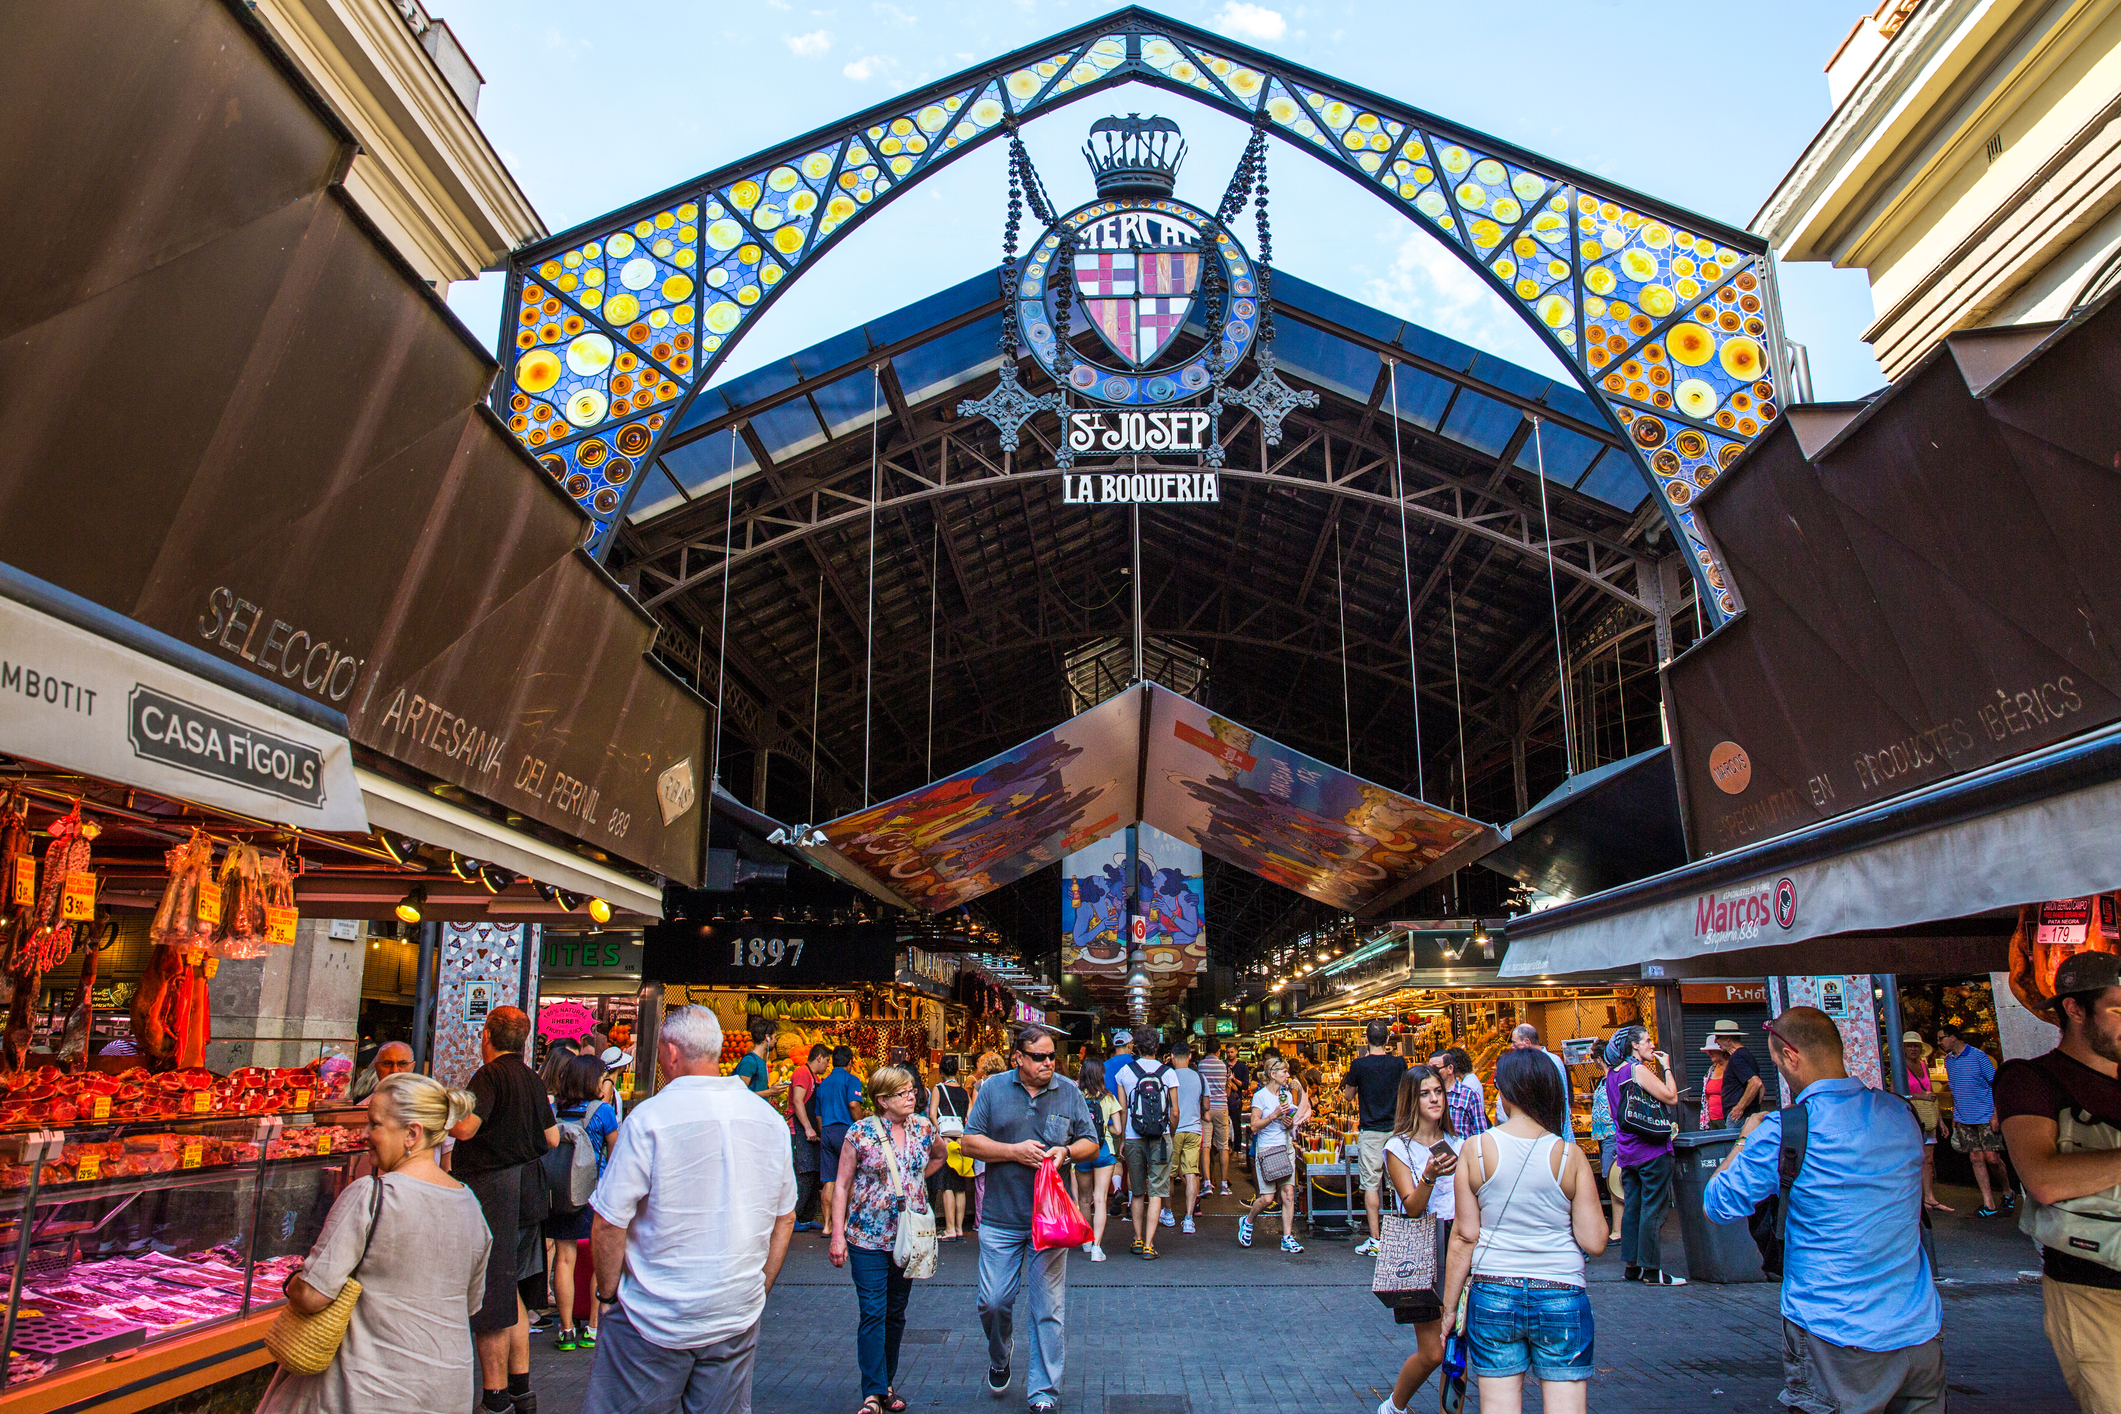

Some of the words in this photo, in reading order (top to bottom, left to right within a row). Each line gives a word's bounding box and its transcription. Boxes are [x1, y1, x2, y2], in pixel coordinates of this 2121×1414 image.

[1078, 212, 1202, 249] MERCAT
[1102, 412, 1211, 451] JOSEP
[1064, 474, 1094, 503] LA
[1100, 474, 1219, 503] BOQUERIA
[1, 660, 97, 717] MBOTIT
[141, 705, 226, 764] CASA
[229, 732, 316, 790] FÍGOLS
[1808, 773, 1836, 807] EN
[1853, 718, 1975, 790] PRODUCTES
[1713, 753, 1748, 782] MARCOS
[513, 754, 547, 799] DEL
[547, 772, 600, 825] PERNIL
[607, 808, 632, 838] 889
[66, 885, 94, 896] BALAGUER
[270, 917, 293, 926] BELLOTA
[1694, 892, 1771, 937] Marcos
[2052, 926, 2070, 942] 179
[730, 937, 805, 968] 1897
[543, 1008, 559, 1019] 100%
[560, 1007, 588, 1020] NATURAL
[545, 1025, 565, 1036] FRUITS
[567, 1025, 584, 1036] JUICE
[1627, 1110, 1672, 1127] BARCELONA
